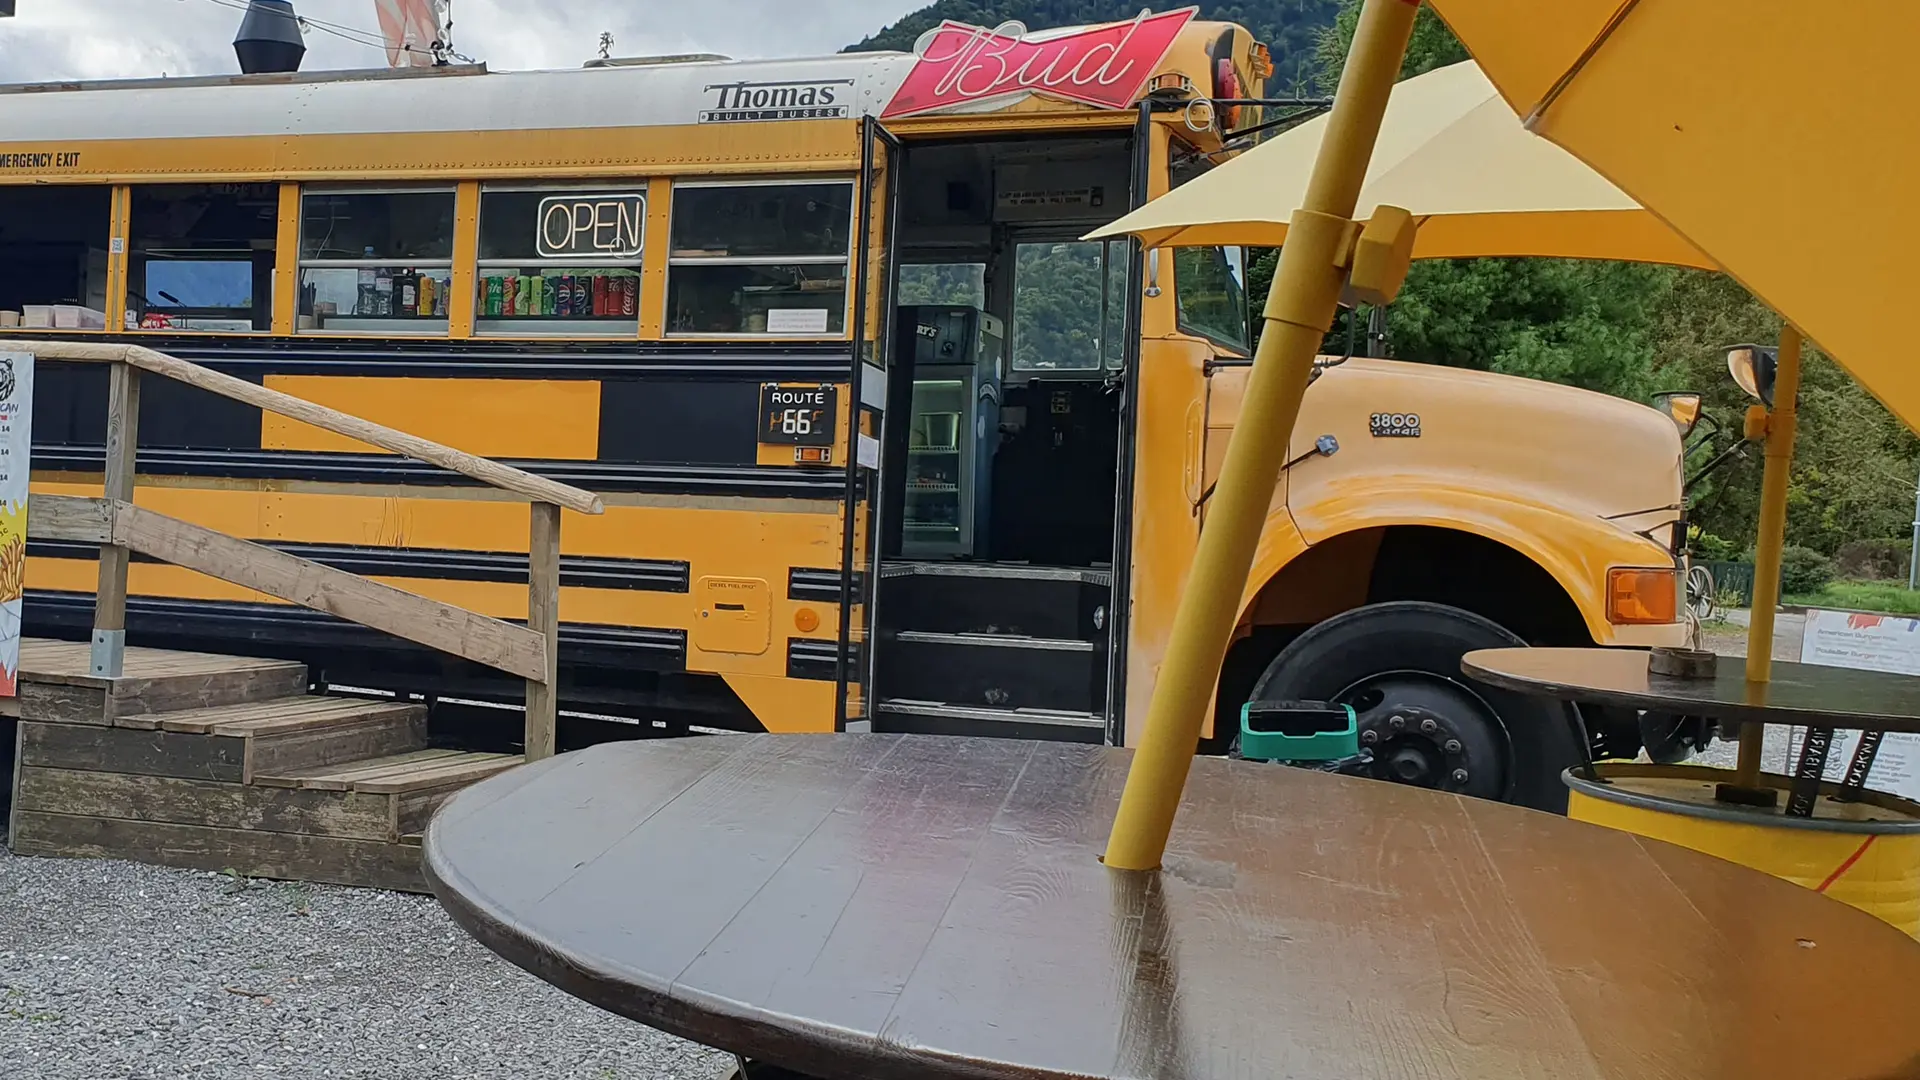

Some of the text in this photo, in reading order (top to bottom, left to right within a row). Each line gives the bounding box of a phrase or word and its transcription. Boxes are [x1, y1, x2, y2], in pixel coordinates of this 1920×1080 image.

[913, 8, 1151, 96] Bud
[706, 80, 838, 109] Thomas
[713, 109, 834, 121] BUILT BUSES
[56, 152, 80, 167] EXIT
[543, 201, 640, 249] OPEN
[771, 392, 824, 404] ROUTE
[782, 409, 811, 434] 66
[1371, 413, 1419, 428] 3800
